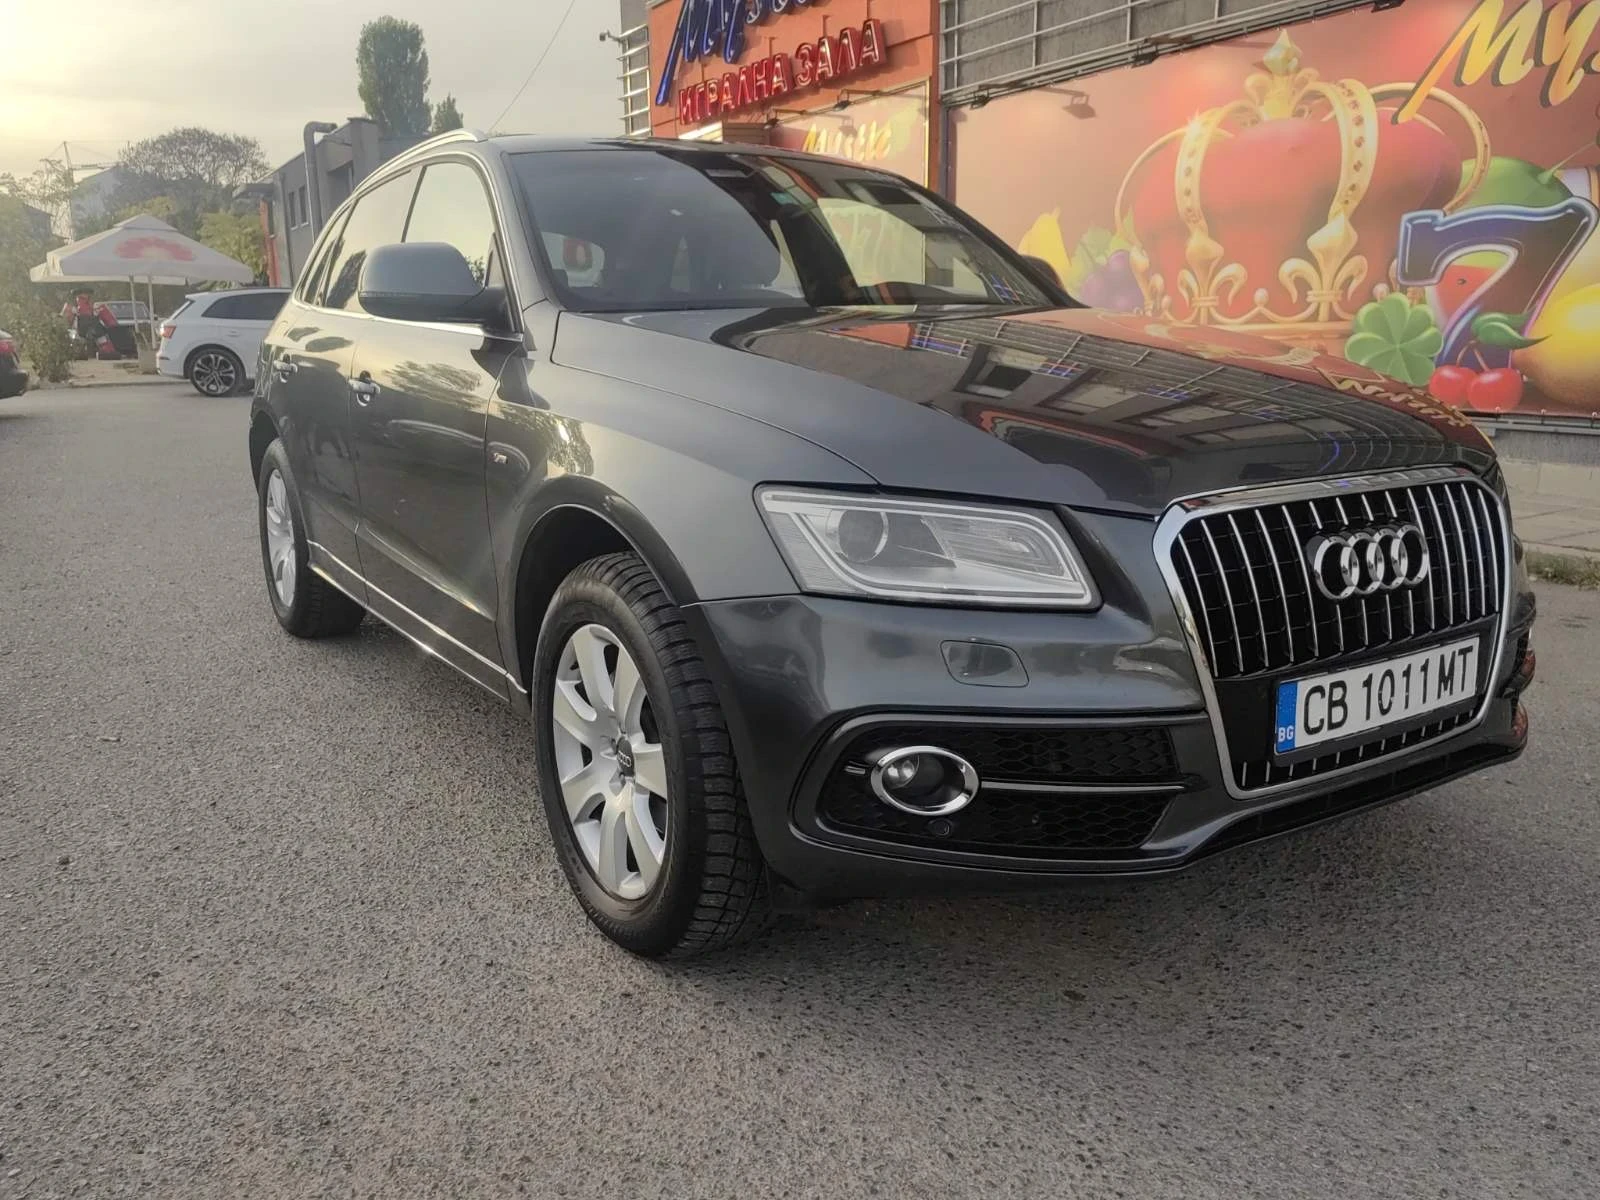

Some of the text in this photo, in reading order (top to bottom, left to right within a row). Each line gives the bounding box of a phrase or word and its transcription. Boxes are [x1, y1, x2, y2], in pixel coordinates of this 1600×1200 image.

[678, 18, 886, 124] ИГРАЛНА ЗАЛА
[1362, 658, 1430, 721] 1011
[1437, 645, 1474, 699] MT
[1277, 725, 1295, 743] BG
